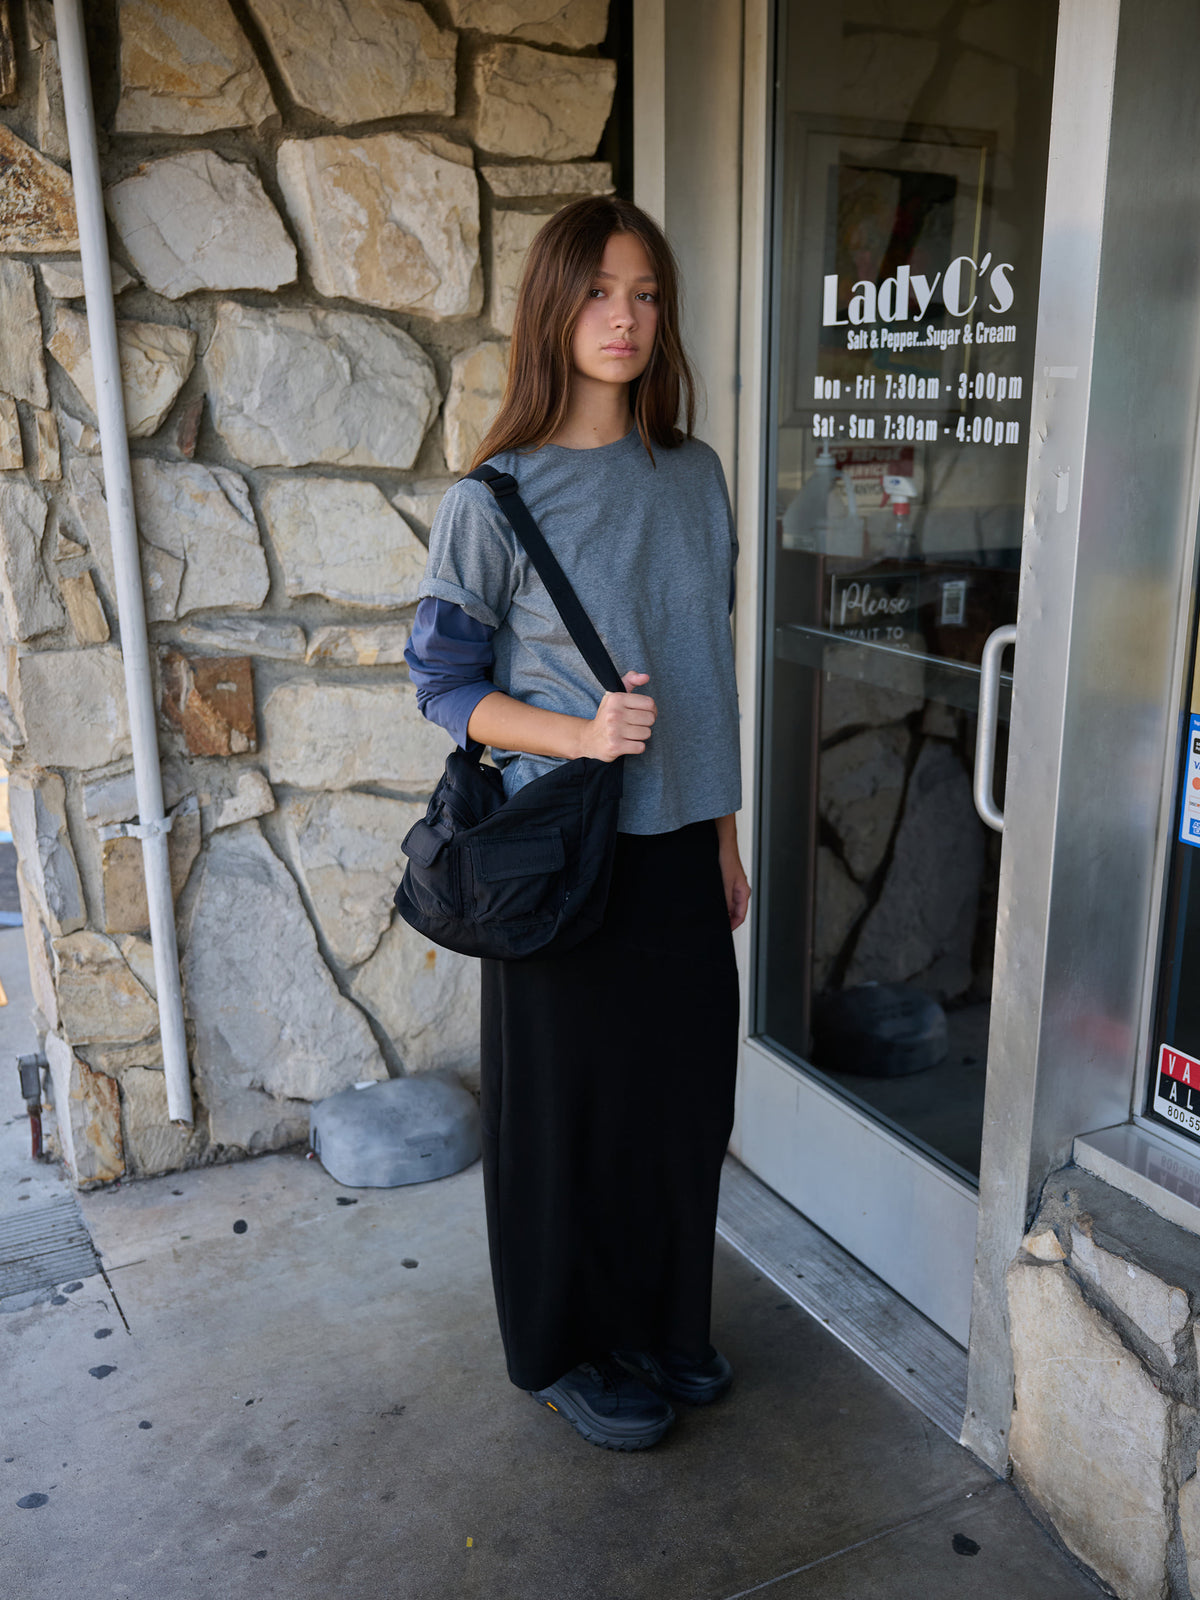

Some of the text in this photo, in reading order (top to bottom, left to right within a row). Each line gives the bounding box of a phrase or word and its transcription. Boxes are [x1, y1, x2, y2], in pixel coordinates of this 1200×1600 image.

[847, 329, 869, 351] Salt
[869, 329, 879, 349] &
[962, 323, 973, 345] &
[975, 321, 1017, 344] Cream
[813, 375, 841, 400] Mon
[855, 374, 876, 400] Fri
[884, 373, 940, 400] 7:30am
[957, 371, 1023, 402] 3:00pm
[812, 413, 835, 438] Sat
[848, 413, 875, 439] Sun
[883, 414, 938, 442] 7:30am
[955, 416, 1020, 447] 4:00pm
[840, 582, 911, 625] Please
[886, 626, 904, 640] TO
